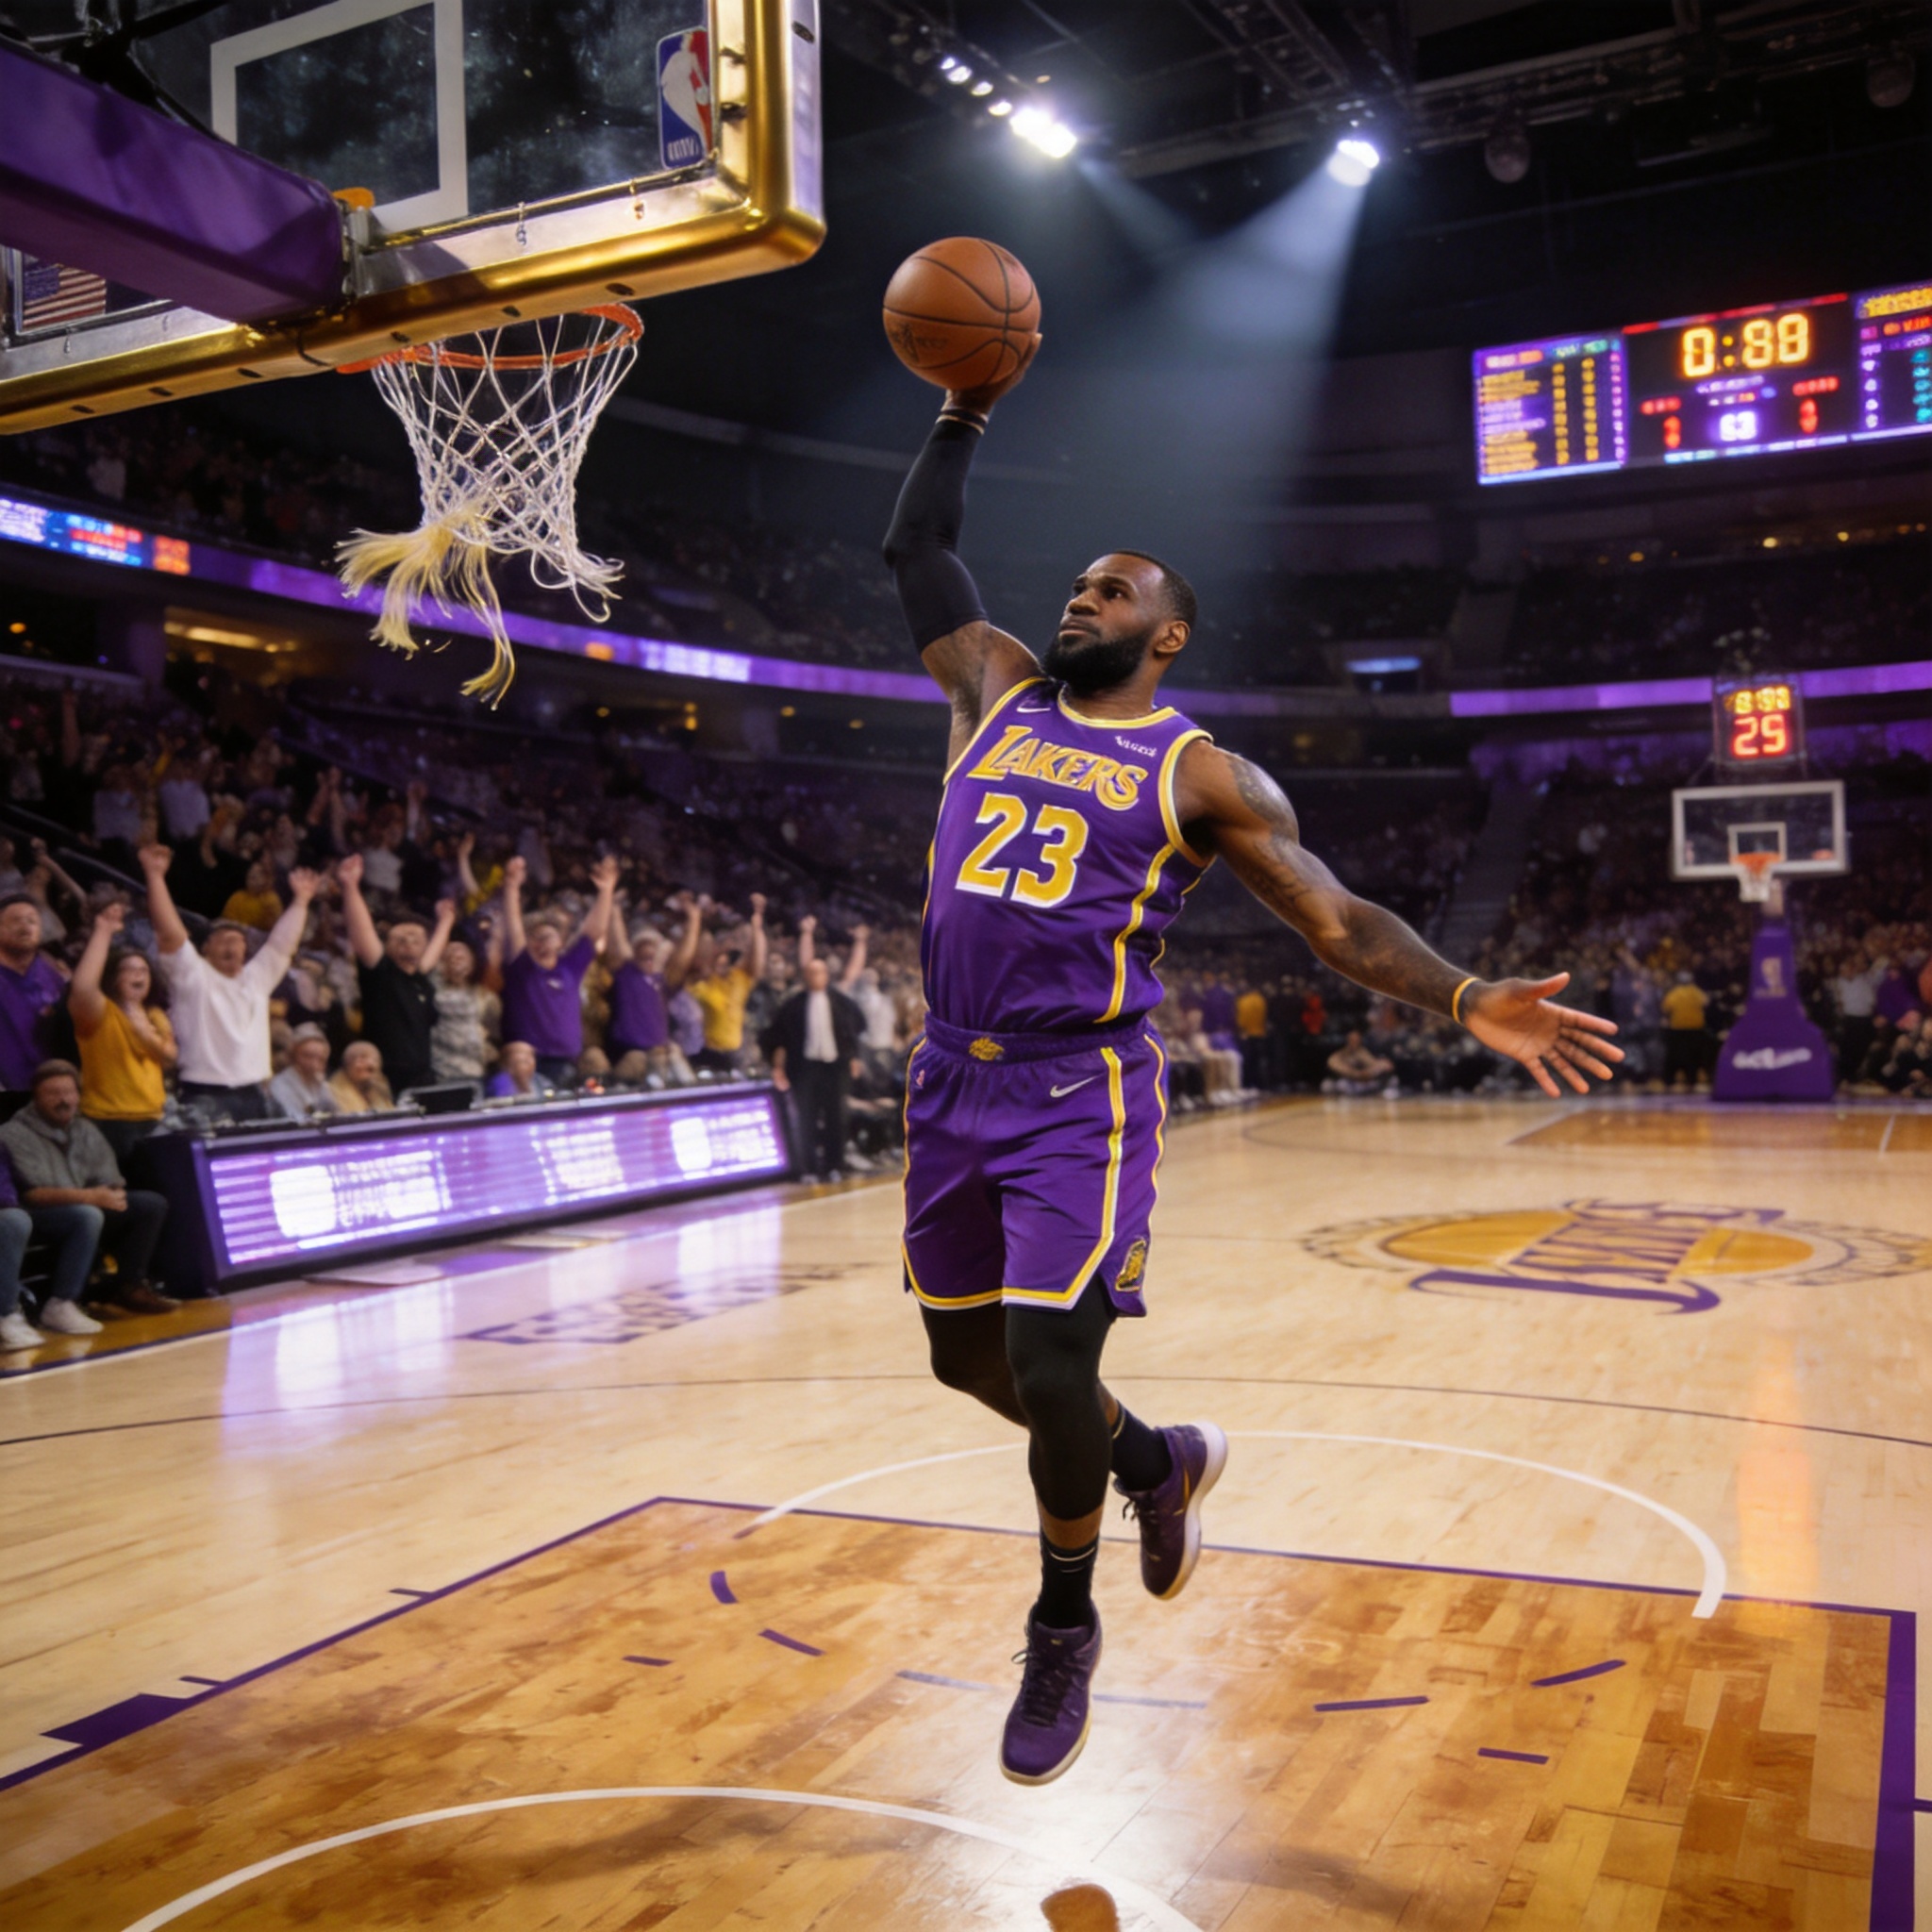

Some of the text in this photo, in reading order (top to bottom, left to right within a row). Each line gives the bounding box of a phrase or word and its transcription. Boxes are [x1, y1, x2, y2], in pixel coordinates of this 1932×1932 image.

[1683, 313, 1808, 376] 0:88
[967, 725, 1148, 810] LAKERS
[956, 791, 1089, 908] 23
